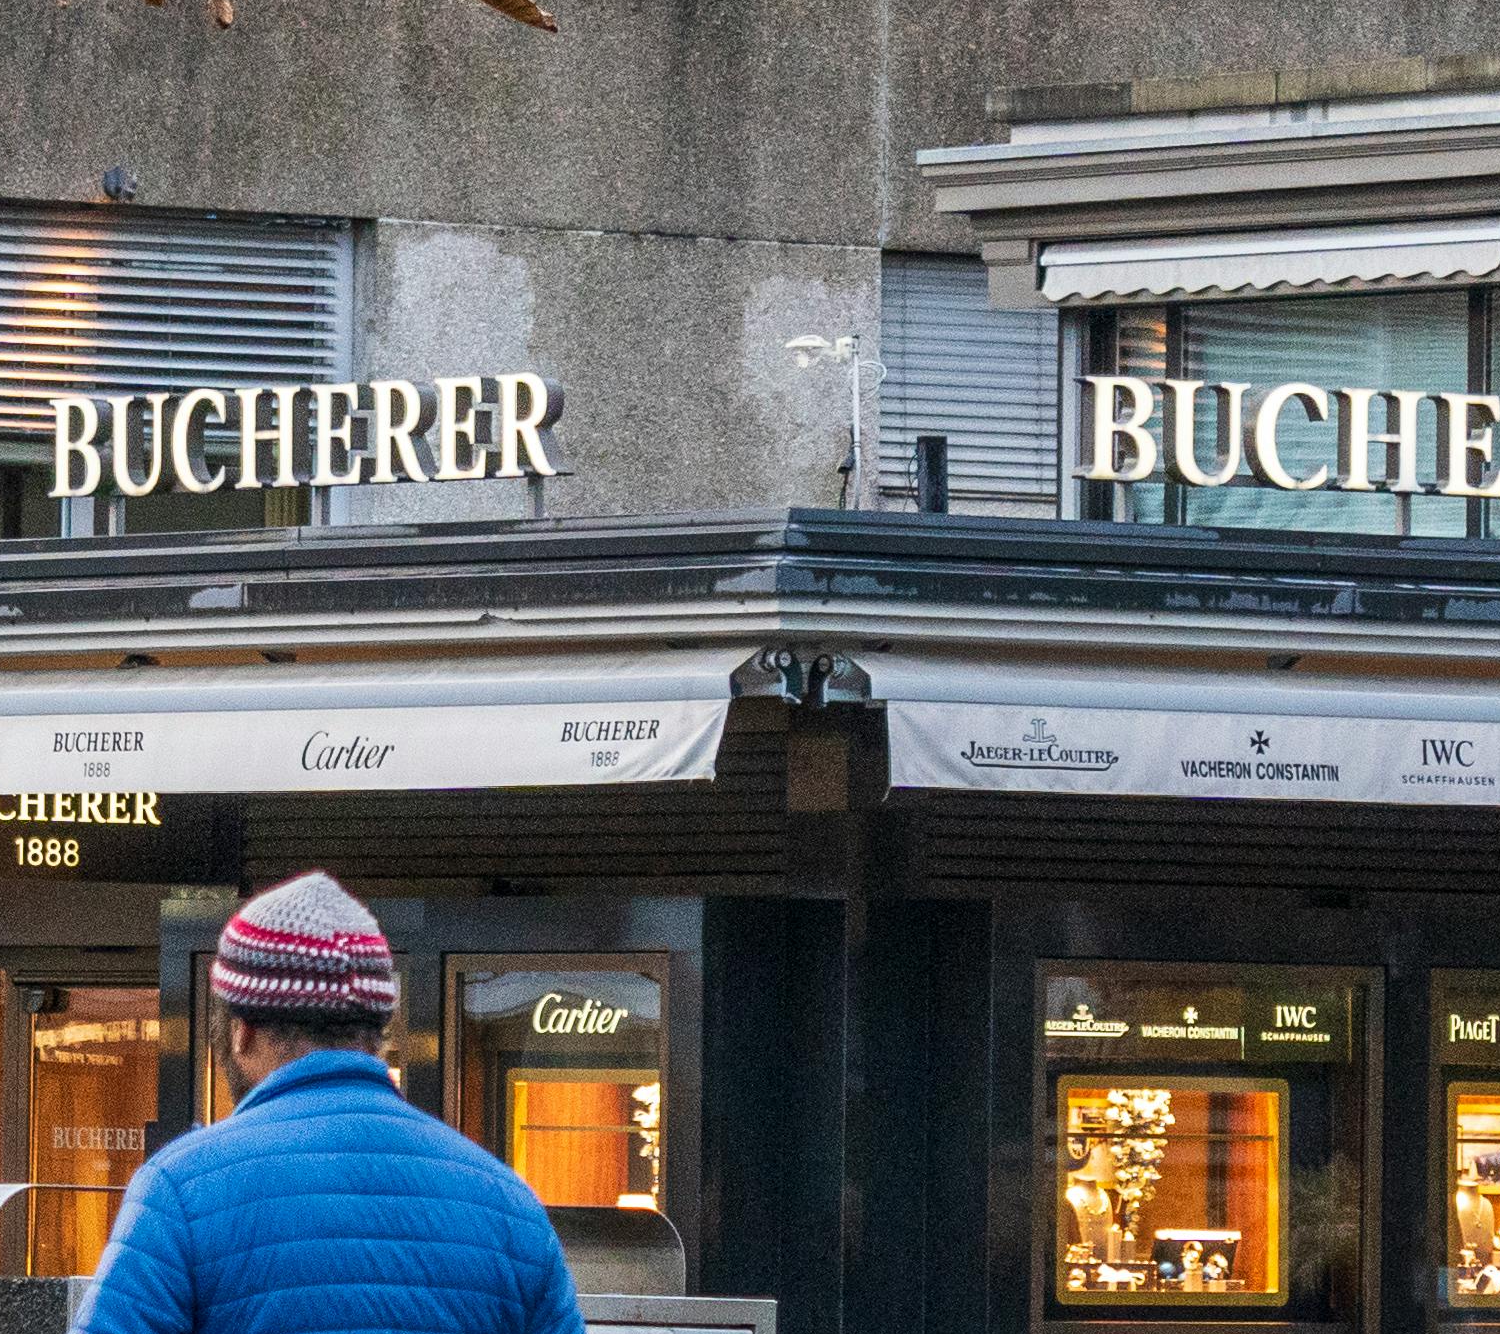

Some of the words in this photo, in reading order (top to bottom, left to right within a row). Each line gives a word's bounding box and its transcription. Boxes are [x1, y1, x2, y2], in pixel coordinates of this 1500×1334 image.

[46, 370, 558, 499] BUCHERER
[52, 731, 145, 753] BUCHERER
[560, 718, 661, 744] BUCHERER
[300, 729, 396, 773] Cartier
[588, 749, 621, 768] 1888
[1420, 738, 1475, 769] IWC
[82, 762, 111, 779] 1888
[1181, 759, 1253, 780] VACHERON
[1256, 761, 1340, 783] CONSTANTIN
[1401, 773, 1497, 787] SCHAFFHAUSEN
[15, 836, 80, 867] 1888
[532, 992, 629, 1037] Cartier
[1275, 1005, 1317, 1029] IWC
[1044, 1019, 1130, 1036] AEGER-LECOULTRE
[1141, 1025, 1187, 1039] VACHERON
[1187, 1027, 1239, 1040] CONSTANTIN
[1260, 1031, 1331, 1043] SCHAFFHAUSEN
[1450, 1014, 1500, 1044] PIAGET
